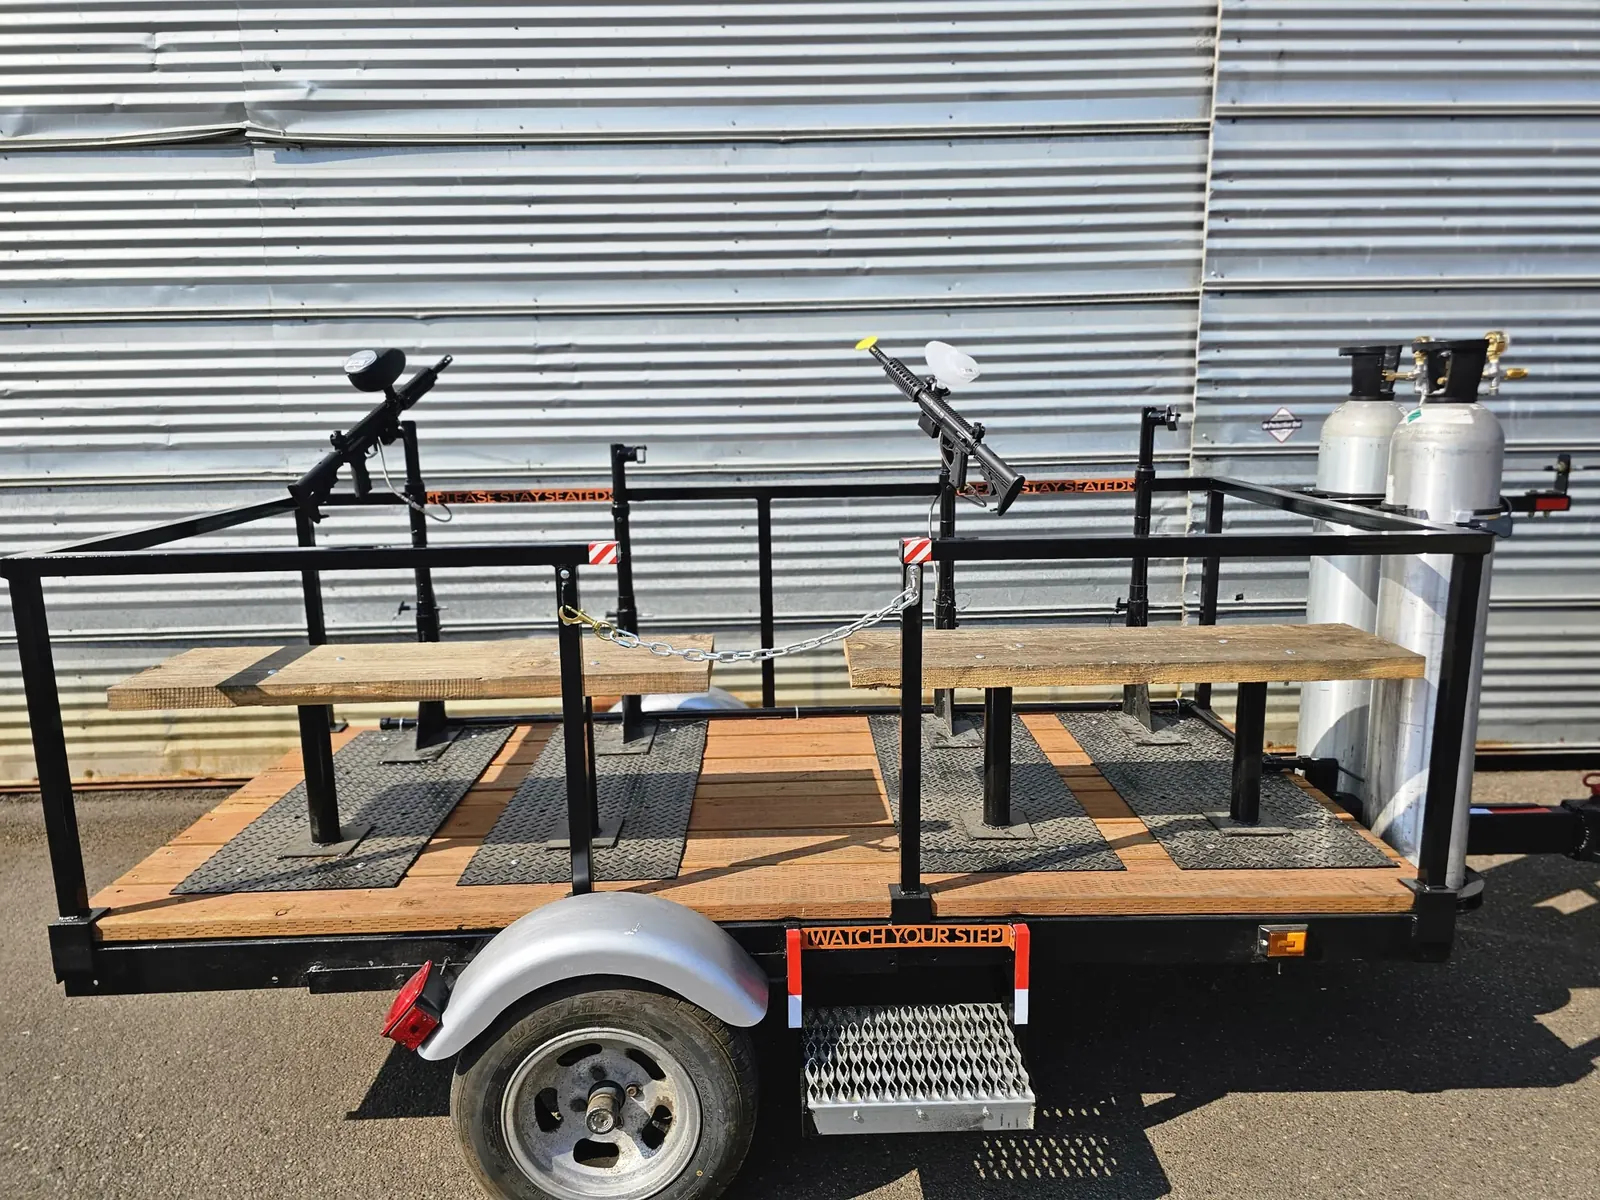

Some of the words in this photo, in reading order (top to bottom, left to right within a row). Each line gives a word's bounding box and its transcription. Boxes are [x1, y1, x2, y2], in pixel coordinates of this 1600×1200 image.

[1021, 481, 1061, 494] STAY
[1064, 480, 1126, 492] SEATED
[435, 491, 496, 504] PLEASE
[500, 491, 542, 503] STAY
[544, 489, 608, 502] SEATED
[809, 927, 886, 946] WATCH
[892, 926, 949, 945] YOUR
[954, 926, 1002, 944] STEP
